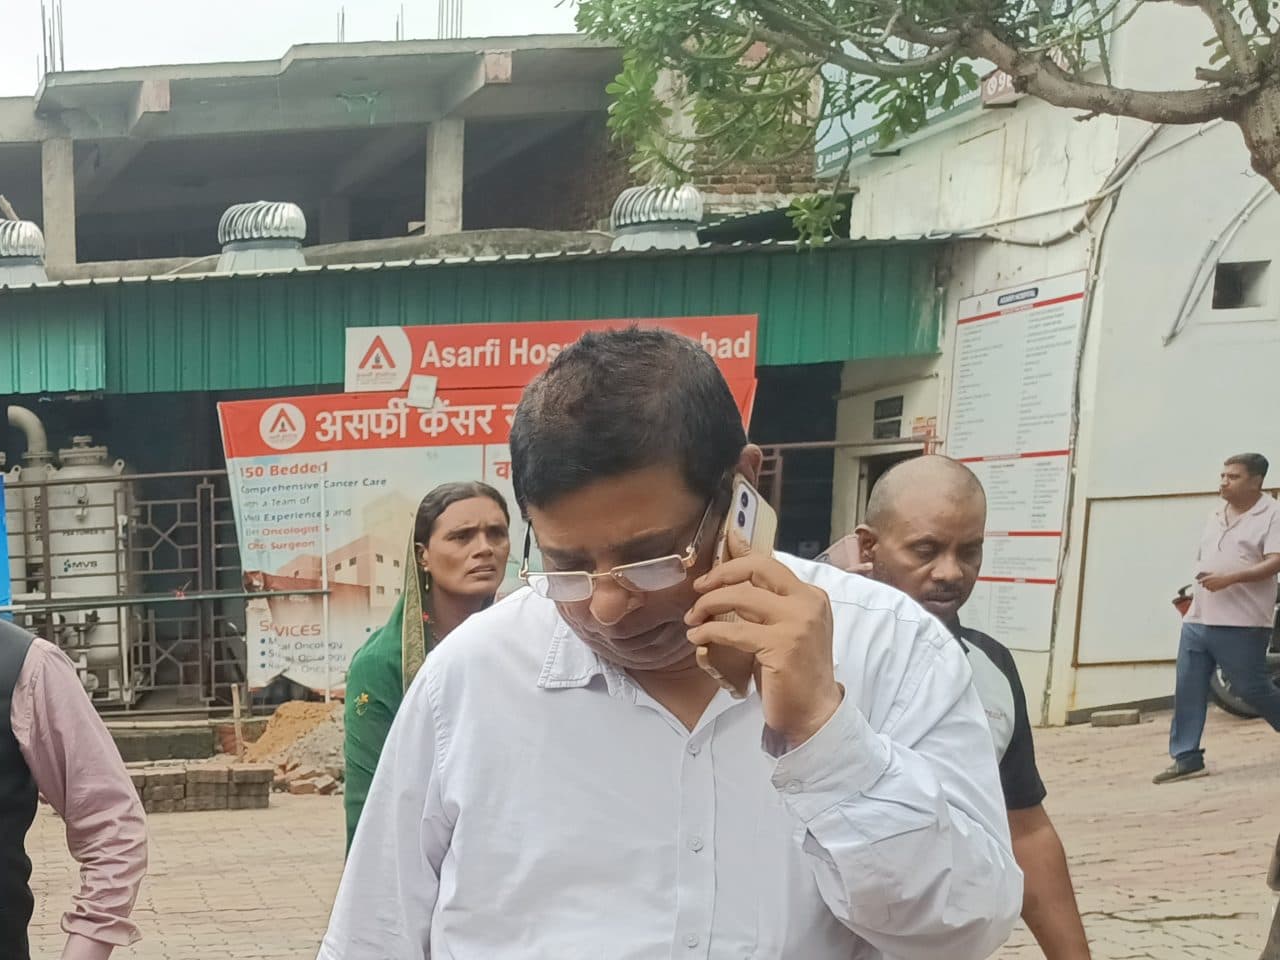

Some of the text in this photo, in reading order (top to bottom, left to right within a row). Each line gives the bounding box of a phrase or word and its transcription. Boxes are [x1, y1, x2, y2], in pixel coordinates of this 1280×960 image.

[420, 338, 501, 368] Asarfi
[240, 465, 265, 479] 150
[241, 478, 387, 495] Comprehensive Cancer Care
[272, 497, 297, 507] Team
[300, 496, 310, 505] of
[332, 508, 352, 518] and
[262, 525, 320, 537] Oncologist
[271, 539, 316, 552] Surgeon
